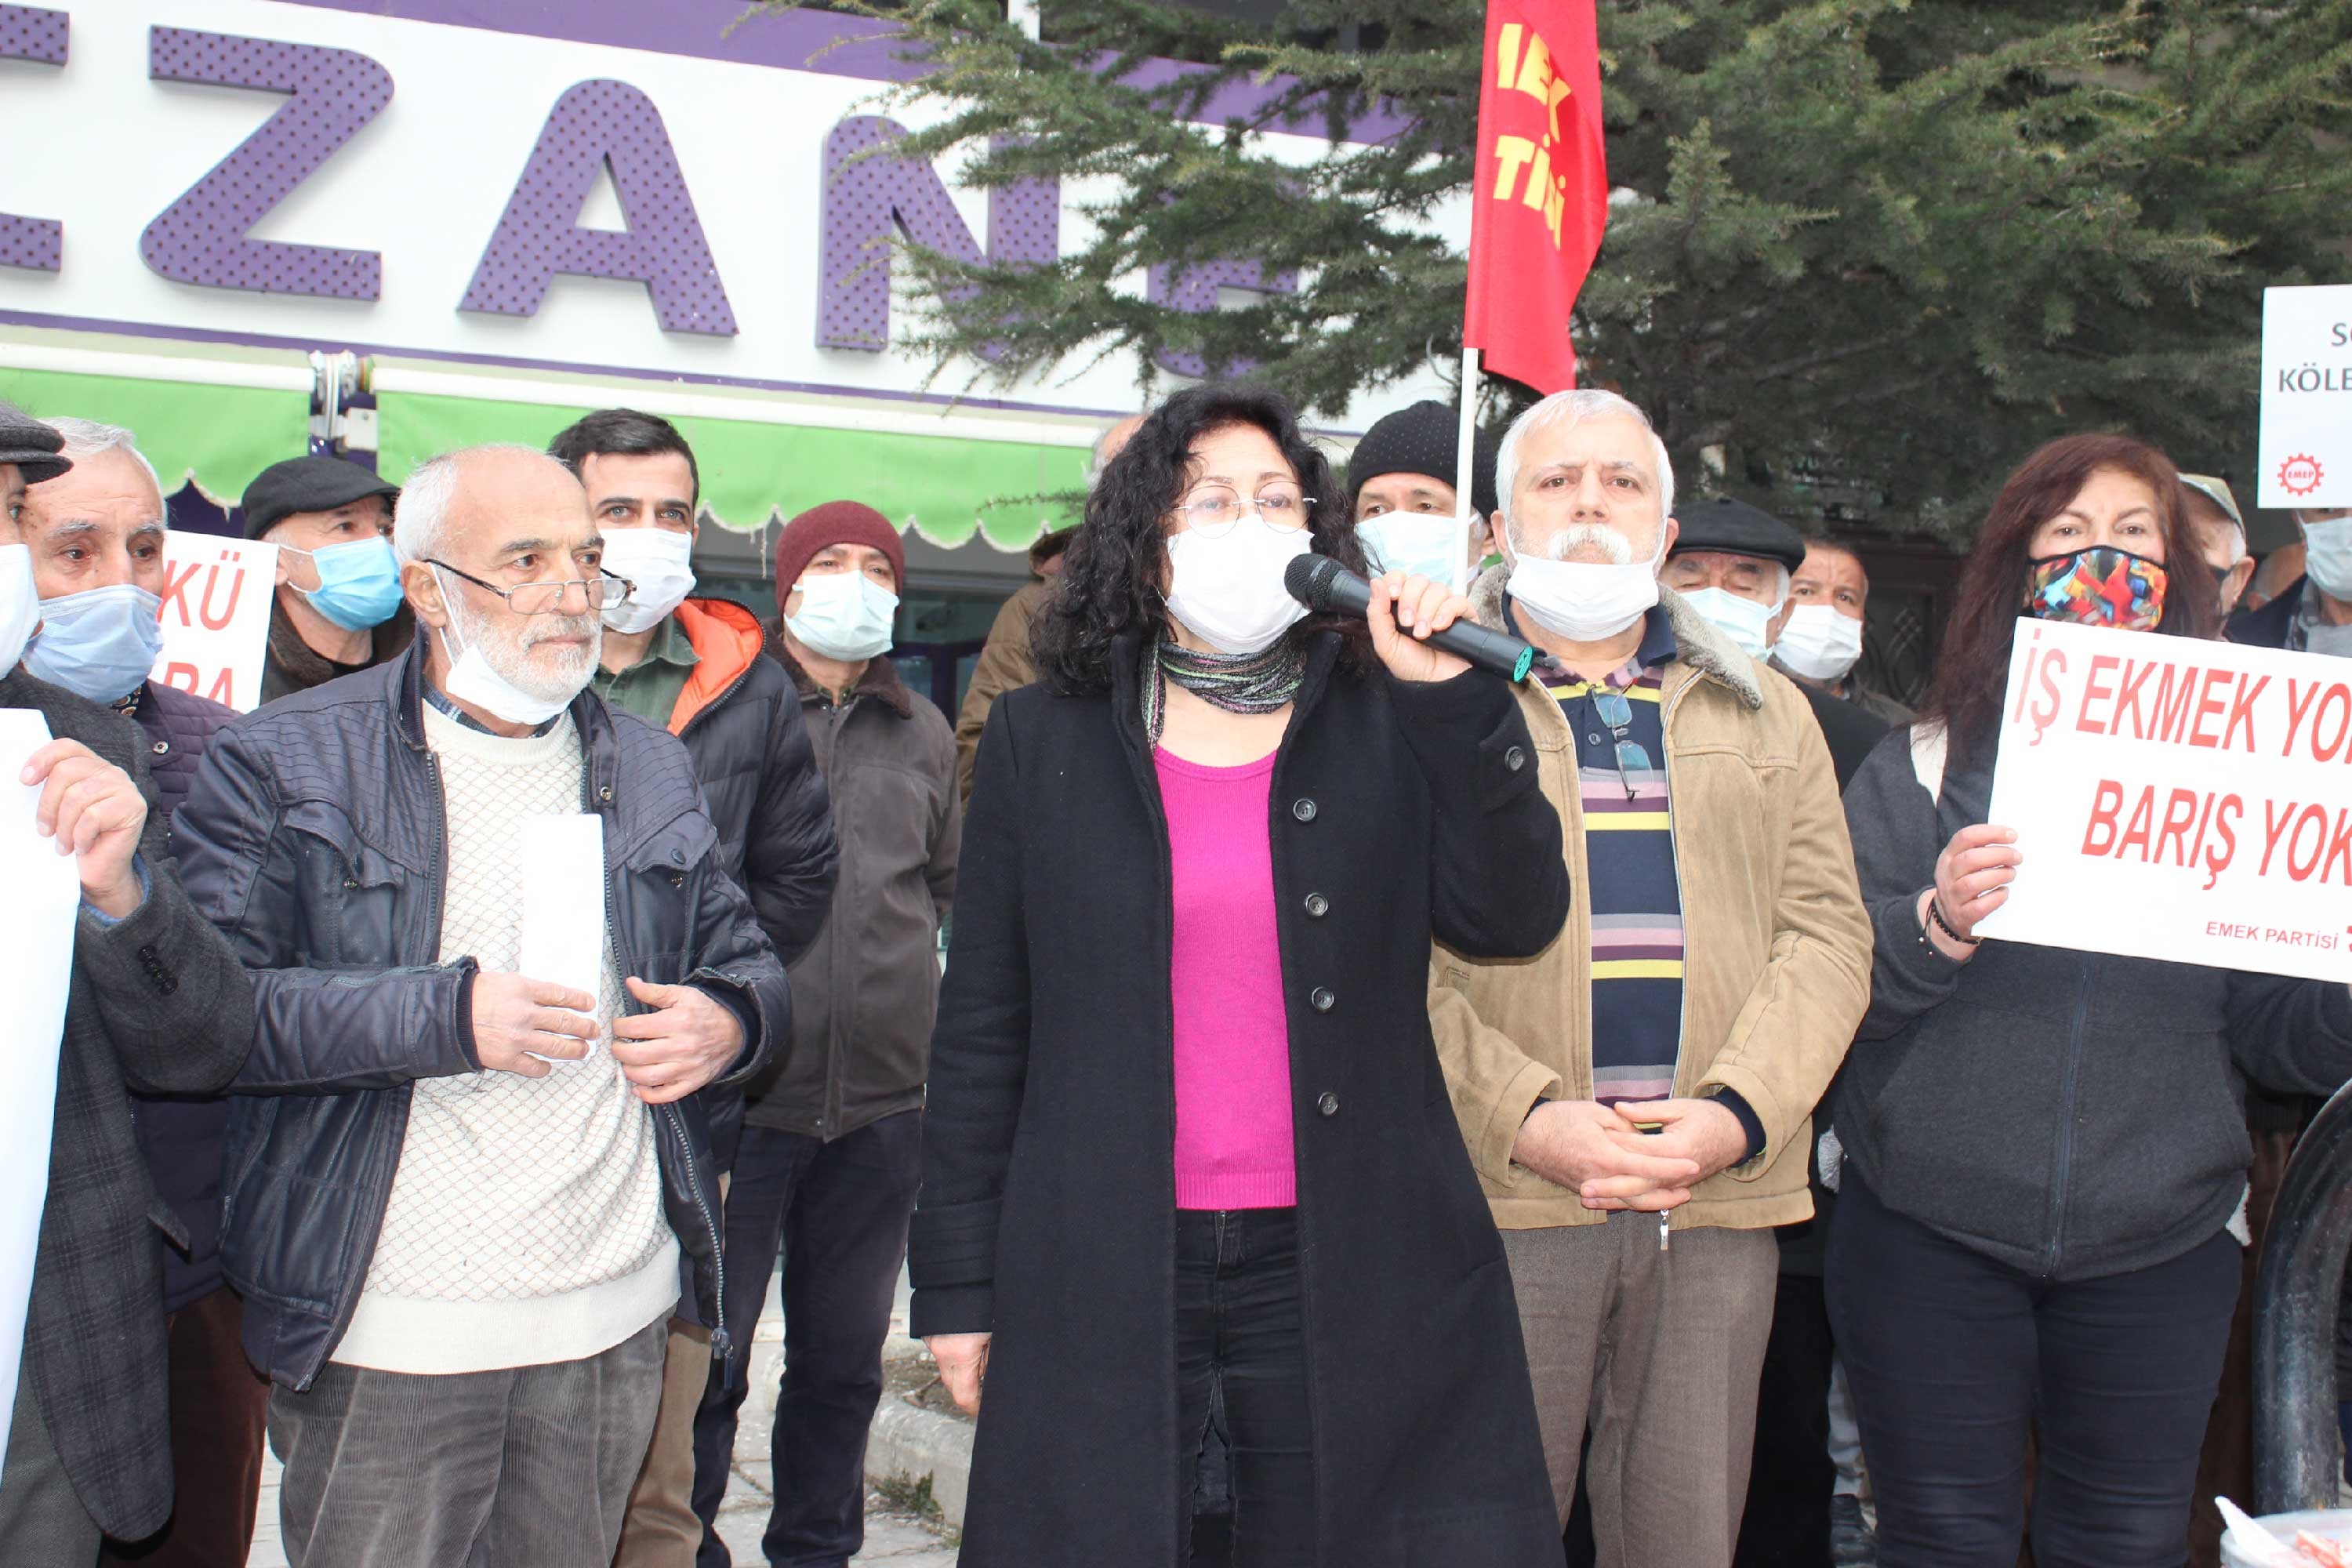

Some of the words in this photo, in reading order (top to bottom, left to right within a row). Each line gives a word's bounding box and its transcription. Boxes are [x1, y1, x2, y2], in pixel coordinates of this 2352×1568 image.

[0, 2, 1305, 378] ZAN
[2331, 322, 2352, 347] S
[2013, 627, 2067, 746] İŞ
[2075, 654, 2273, 753] EKMEK
[2282, 677, 2352, 764] YO
[2081, 779, 2244, 891] BARIŞ
[2259, 798, 2352, 887] YOK
[2205, 920, 2259, 942] EMEK
[2265, 928, 2339, 950] PARTİSİ
